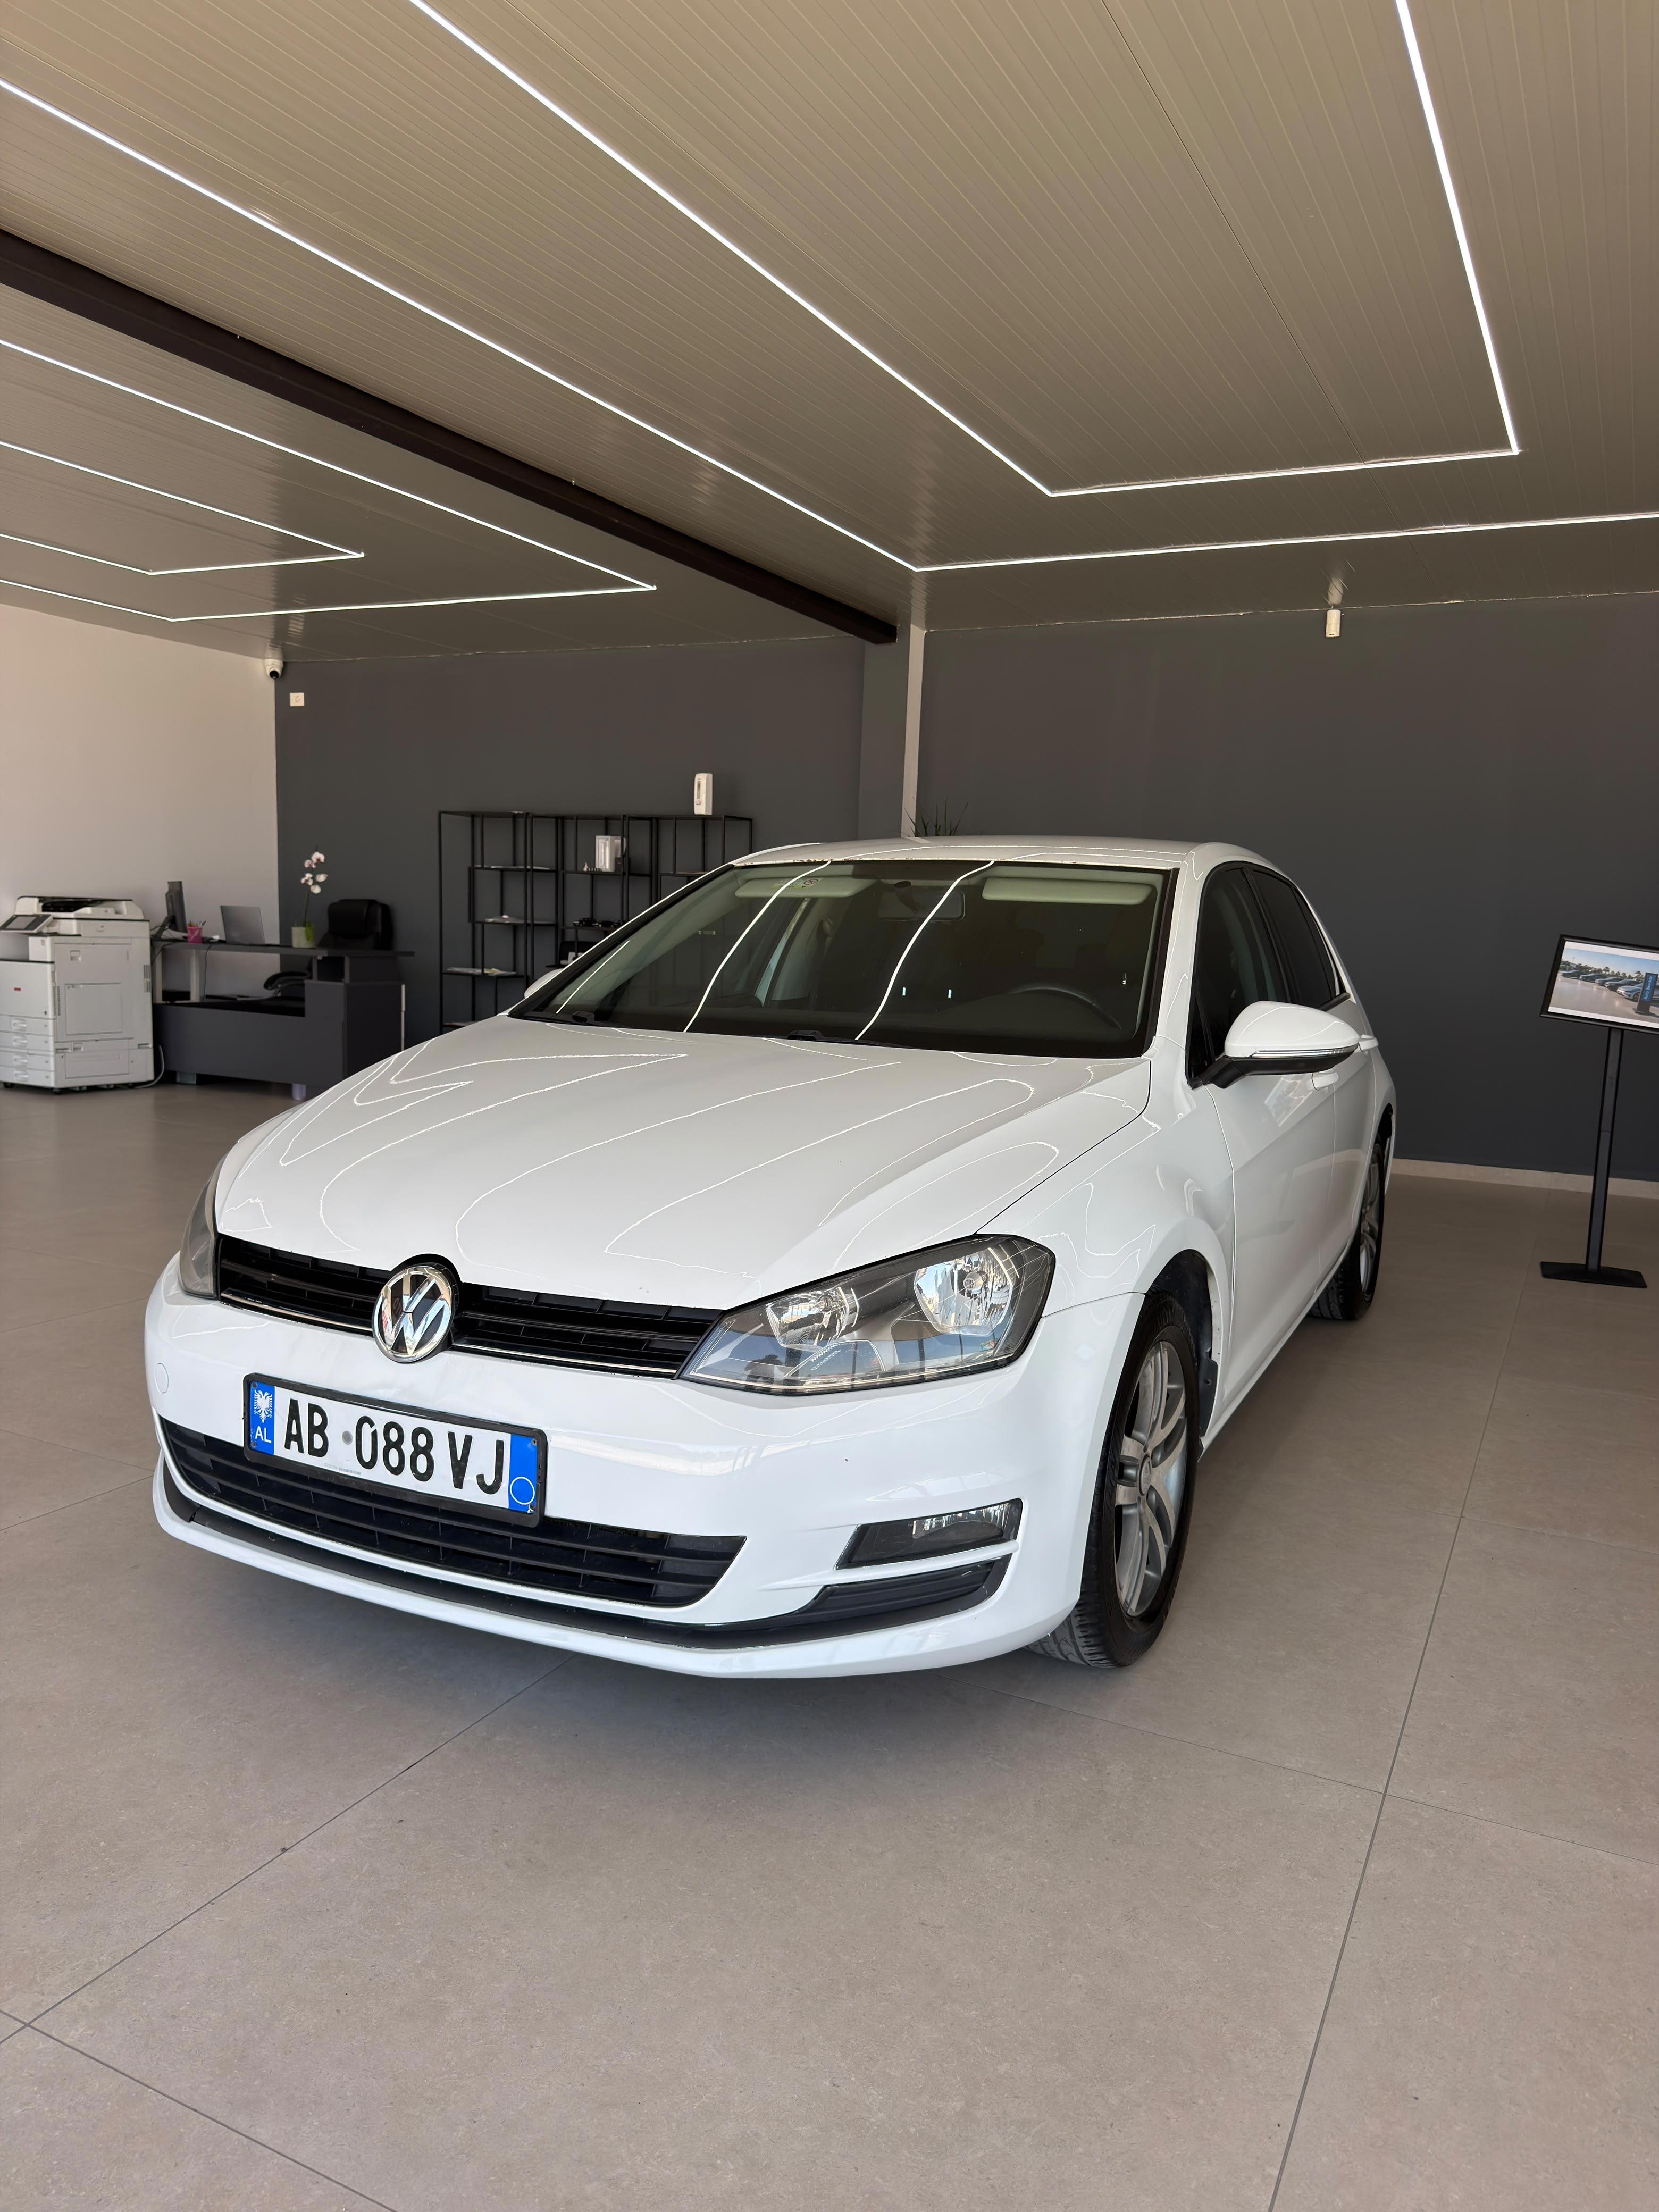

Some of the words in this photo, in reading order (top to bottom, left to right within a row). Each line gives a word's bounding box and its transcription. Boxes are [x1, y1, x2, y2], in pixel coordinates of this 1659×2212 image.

[255, 1426, 272, 1443] AL
[284, 1398, 329, 1457] AB
[356, 1415, 434, 1482] 088
[448, 1431, 505, 1495] VJ
